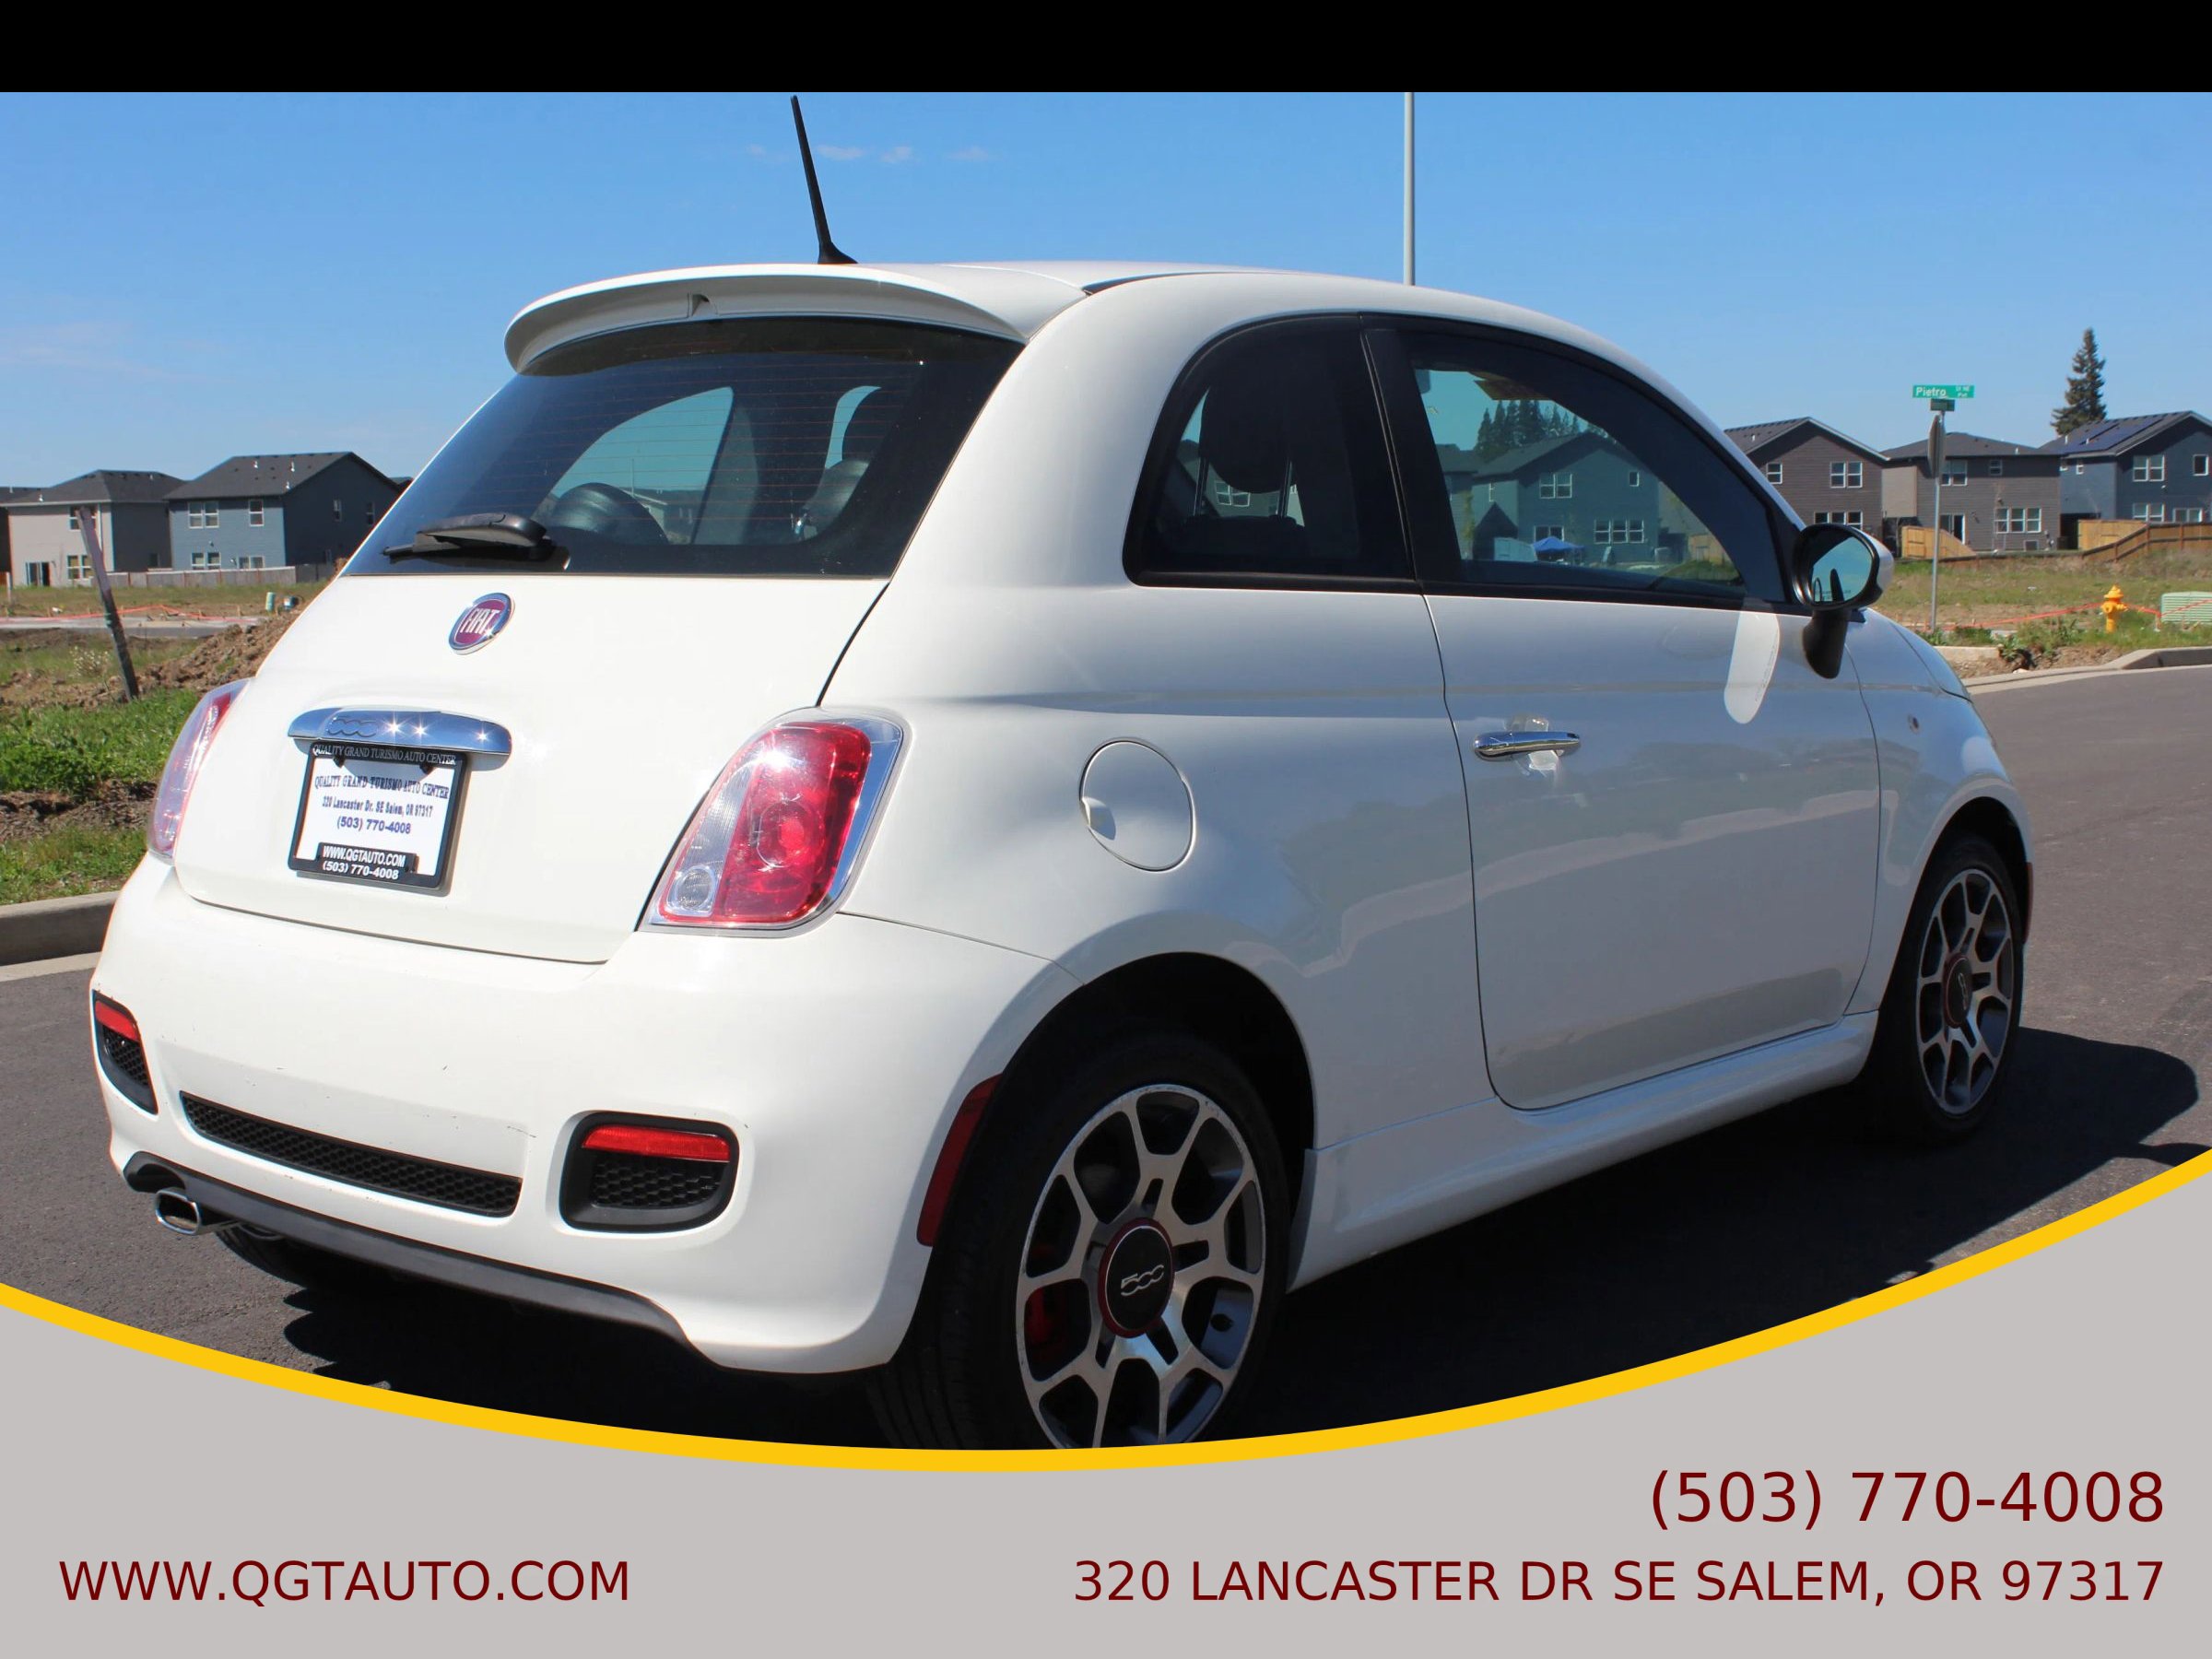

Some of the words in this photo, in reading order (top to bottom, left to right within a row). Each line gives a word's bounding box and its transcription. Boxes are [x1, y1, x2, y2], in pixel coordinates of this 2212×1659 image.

[1915, 386, 1947, 397] Pietro
[459, 607, 500, 635] FIAT
[312, 744, 345, 757] QUALITY
[345, 747, 370, 758] GRAND
[371, 748, 404, 761] TURISMO
[404, 751, 426, 762] AUTO
[426, 751, 456, 765] CENTER
[314, 776, 342, 790] QUALITY
[343, 776, 368, 788] GRAND
[371, 777, 402, 790] TURISMO
[404, 781, 421, 794] AUTO
[422, 782, 450, 799] CENTER
[333, 797, 363, 810] Lancaster
[365, 800, 373, 812] Dr.
[375, 801, 384, 813] SE
[385, 803, 405, 817] Salem,
[406, 804, 414, 816] OR
[337, 816, 363, 831] (503)
[366, 818, 411, 834] 770-4008
[323, 845, 406, 867] WWW.QGTAUTO.COM
[323, 860, 349, 874] (503)
[350, 864, 399, 879] 770-4008
[1120, 1264, 1165, 1297] 500
